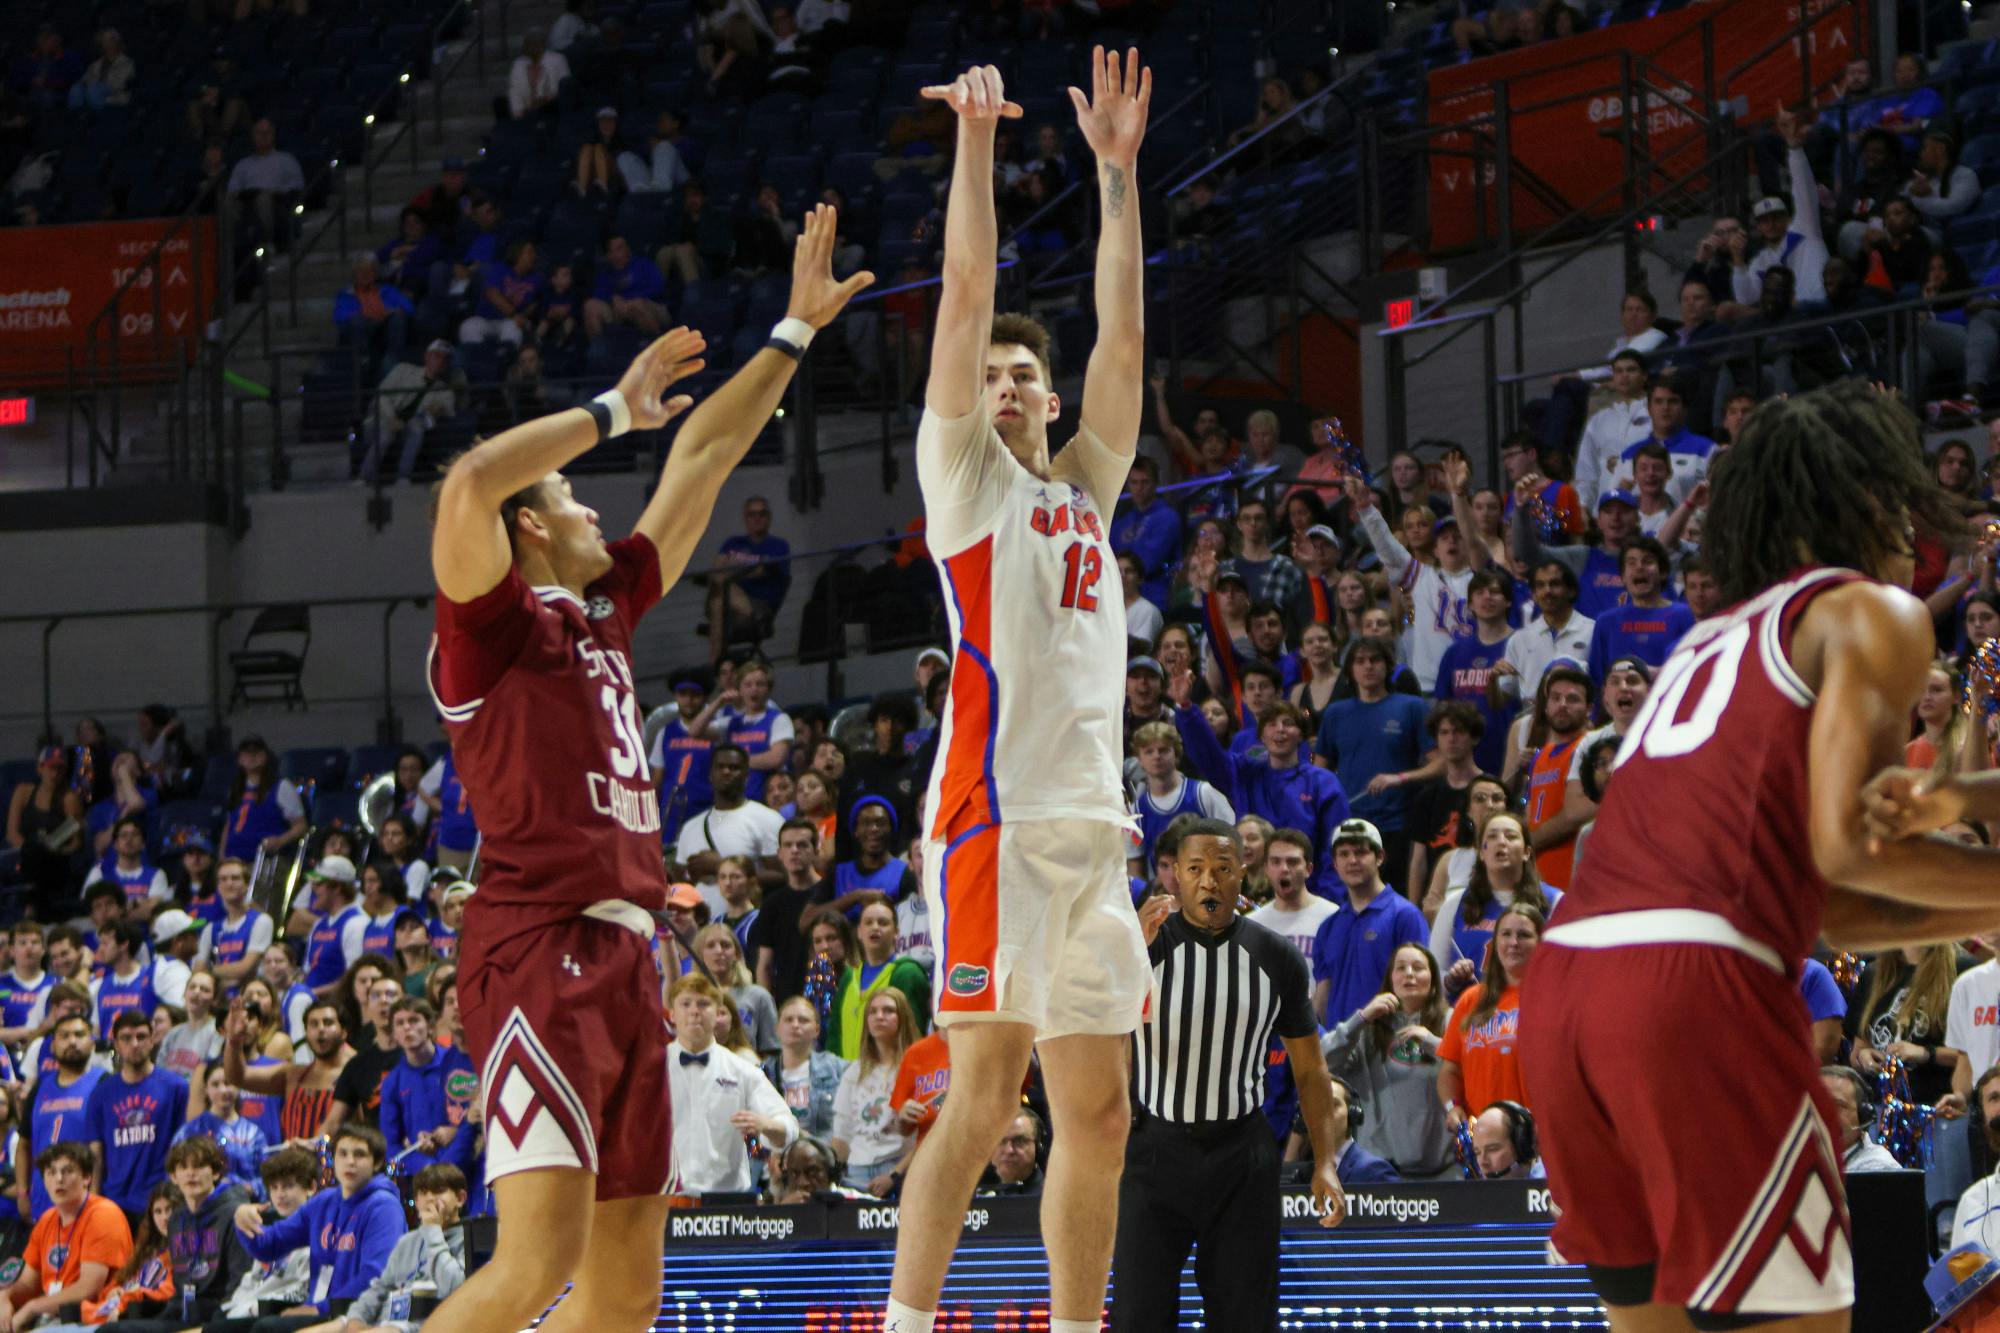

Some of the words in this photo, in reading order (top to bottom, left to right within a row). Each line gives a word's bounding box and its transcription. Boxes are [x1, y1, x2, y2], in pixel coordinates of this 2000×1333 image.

[118, 238, 189, 256] SECON
[1060, 541, 1102, 612] 12
[1453, 668, 1492, 689] FLORI
[602, 684, 651, 782] 31
[113, 1124, 156, 1148] GATORS
[858, 1206, 900, 1230] ROCK
[1359, 1193, 1440, 1222] Mortgage
[672, 1213, 729, 1238] ROCKET
[732, 1215, 794, 1240] Mortgage
